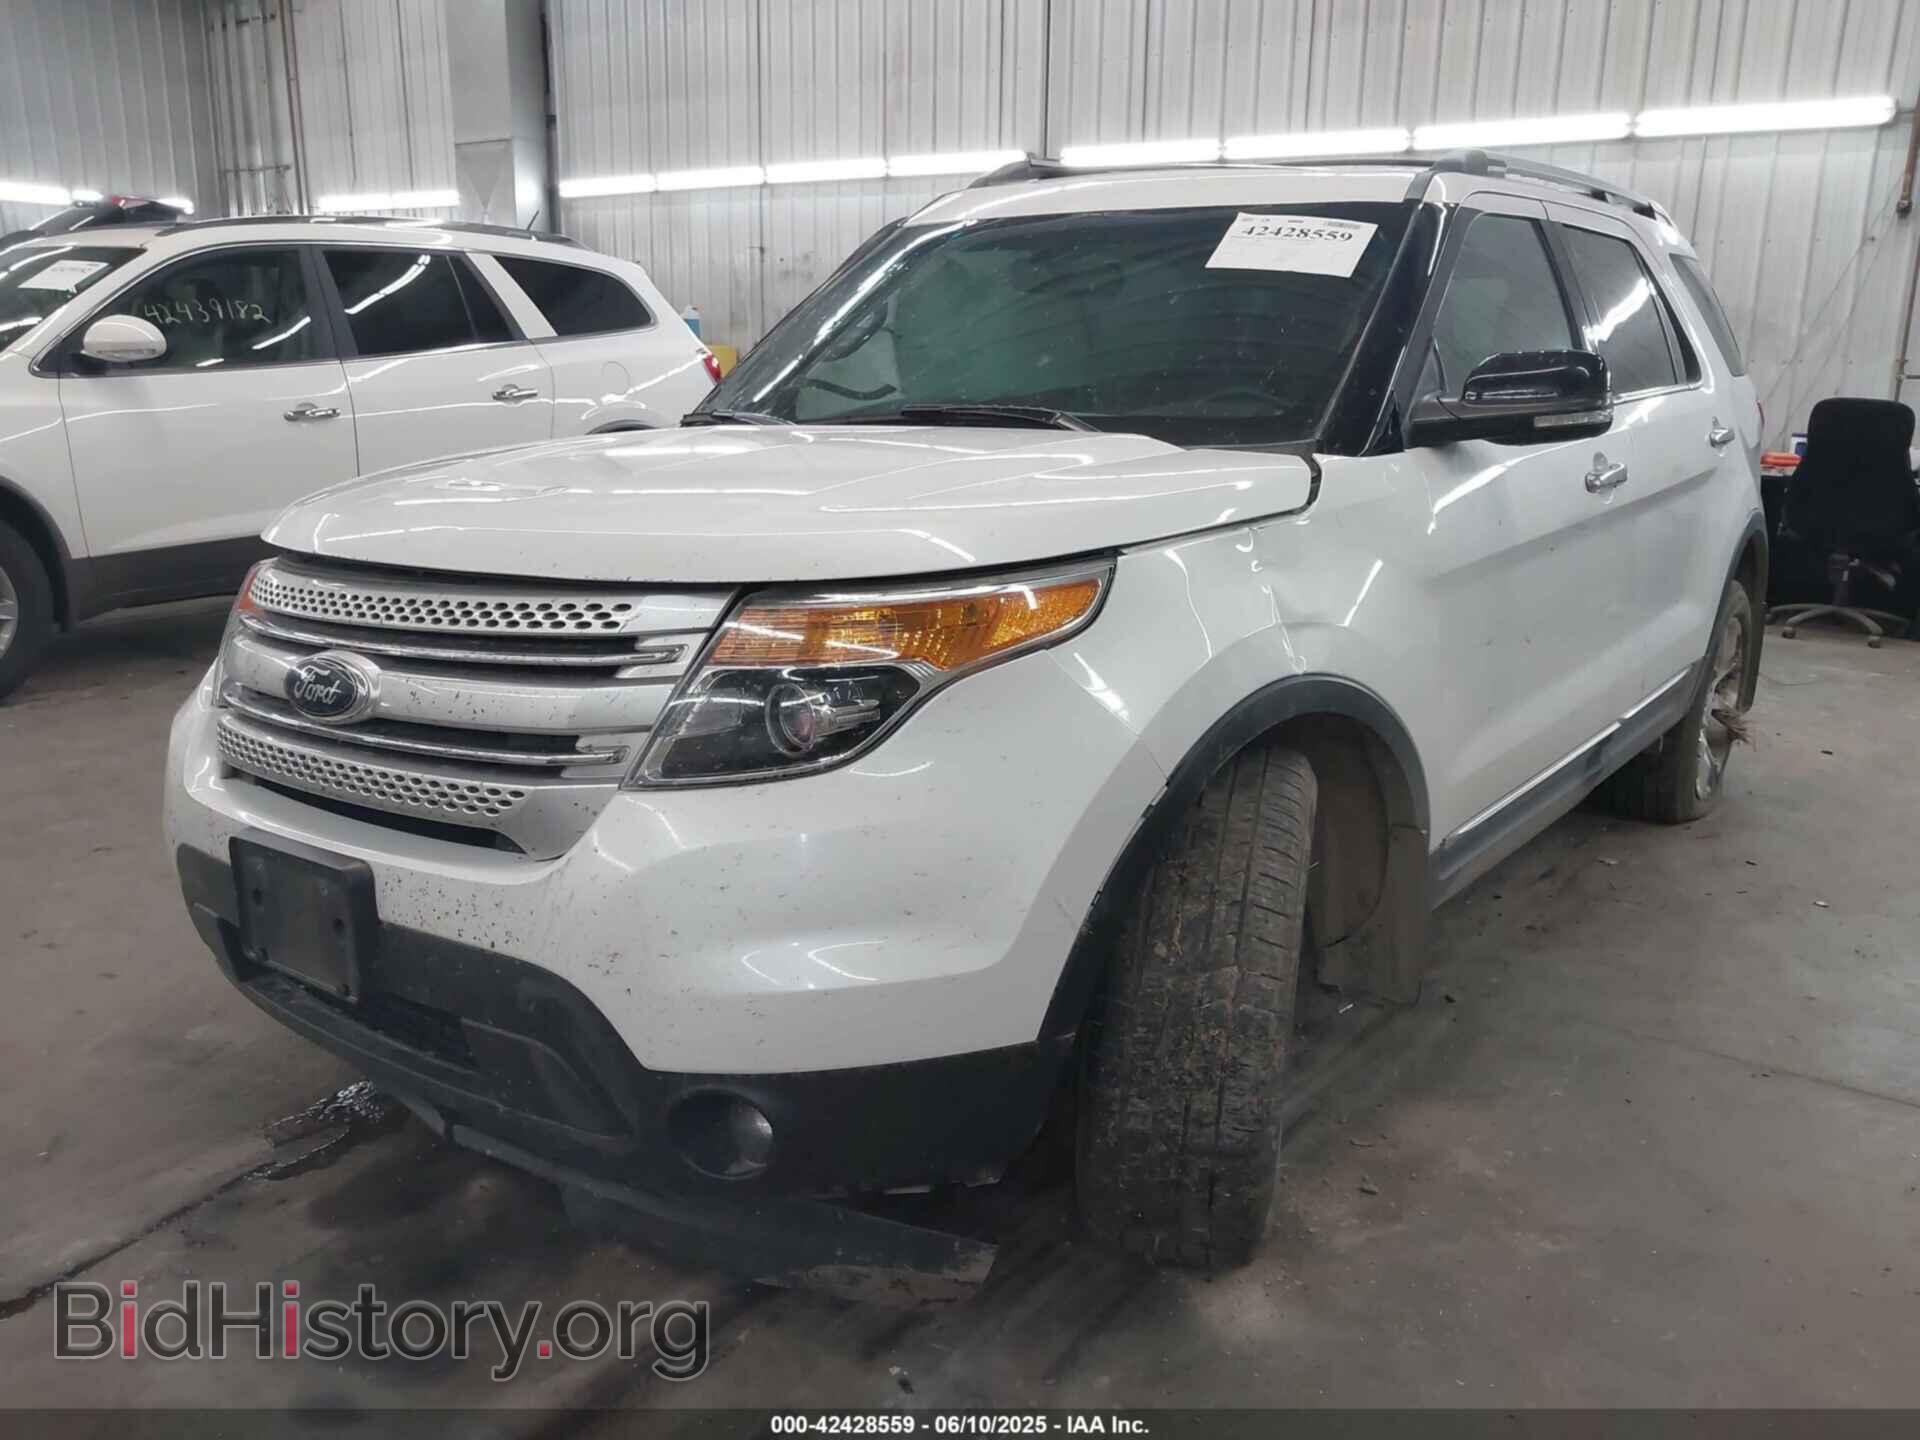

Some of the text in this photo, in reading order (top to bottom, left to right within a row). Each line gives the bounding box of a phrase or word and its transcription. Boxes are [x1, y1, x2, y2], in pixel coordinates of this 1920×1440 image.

[1241, 225, 1354, 242] 42428559
[143, 298, 272, 323] 42439182
[293, 665, 343, 704] Ford
